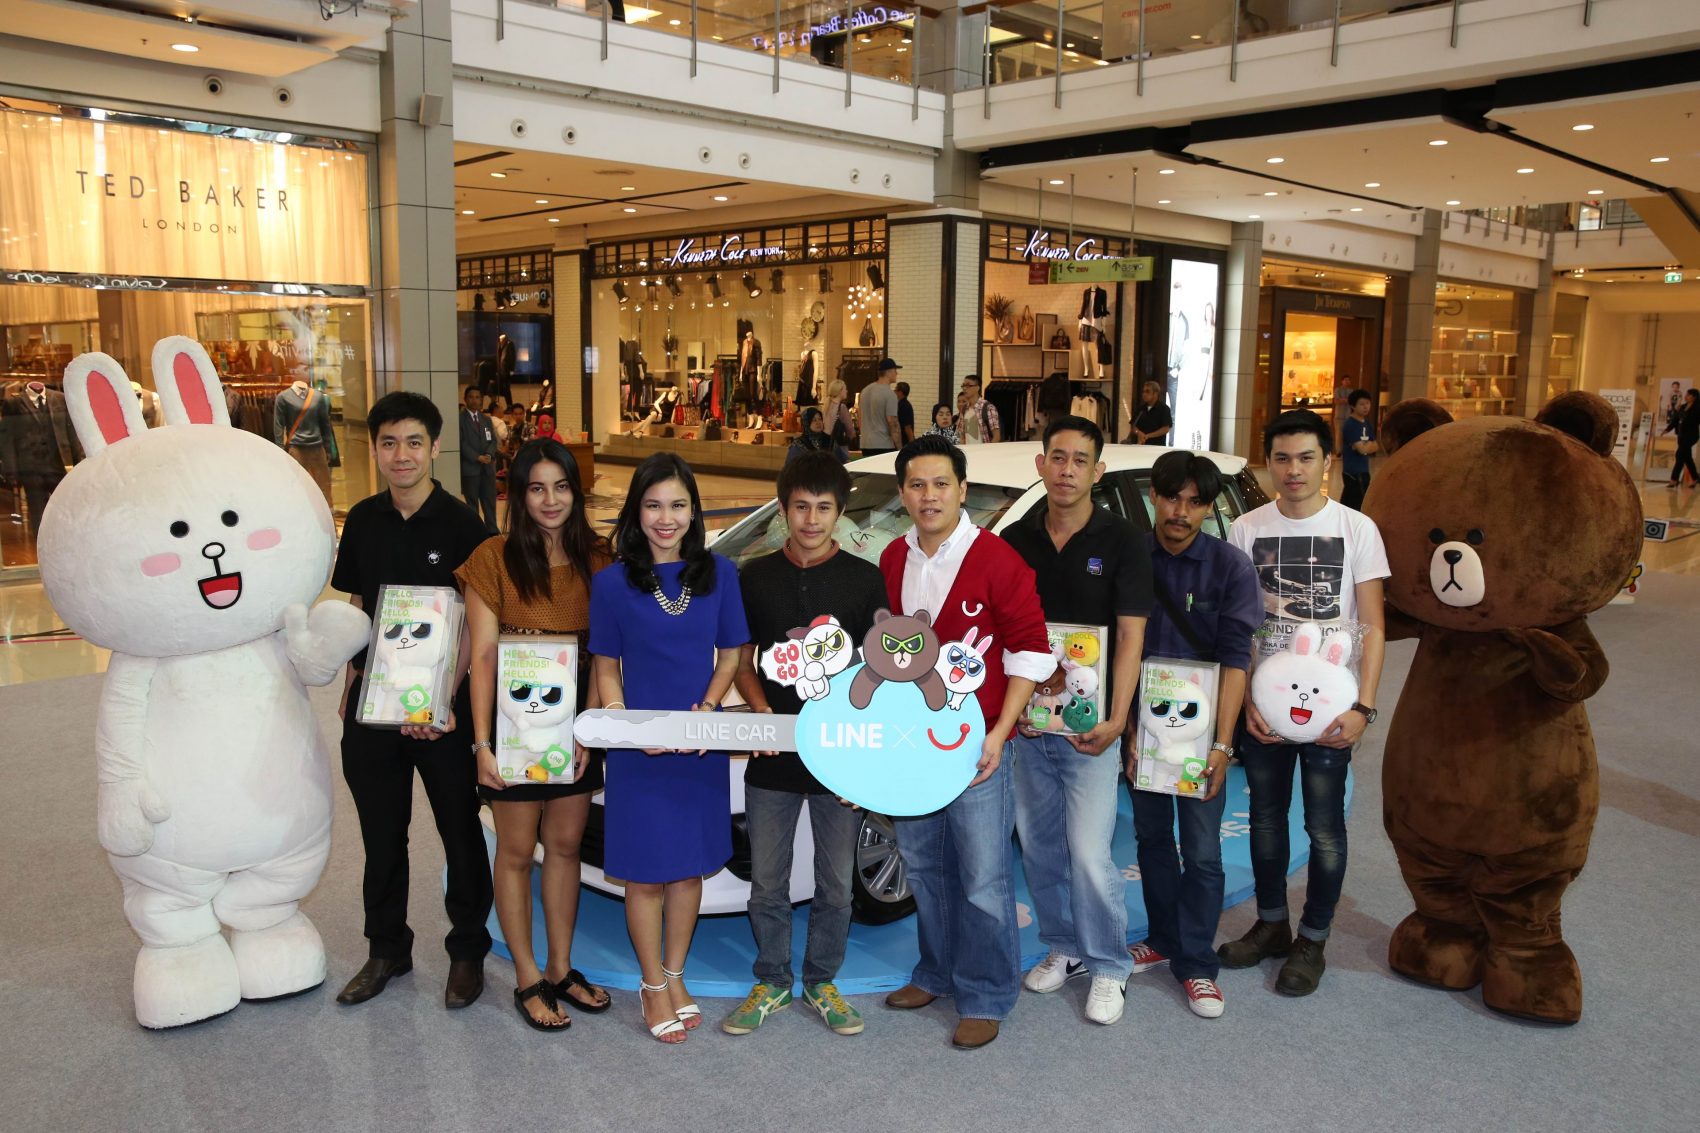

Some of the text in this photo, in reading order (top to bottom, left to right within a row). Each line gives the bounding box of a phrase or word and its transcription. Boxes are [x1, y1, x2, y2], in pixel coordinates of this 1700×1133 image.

[1121, 2, 1172, 18] camer.com
[75, 170, 289, 212] TED BAKER
[142, 218, 238, 234] LONDON
[749, 247, 764, 257] NEW
[764, 246, 780, 256] YORK
[773, 643, 800, 664] GO
[503, 660, 550, 669] FRIENDS!
[776, 663, 799, 680] GO
[684, 722, 777, 742] LINE CAR
[819, 722, 883, 749] LINE
[549, 753, 563, 763] LINE
[1188, 765, 1201, 773] LINE
